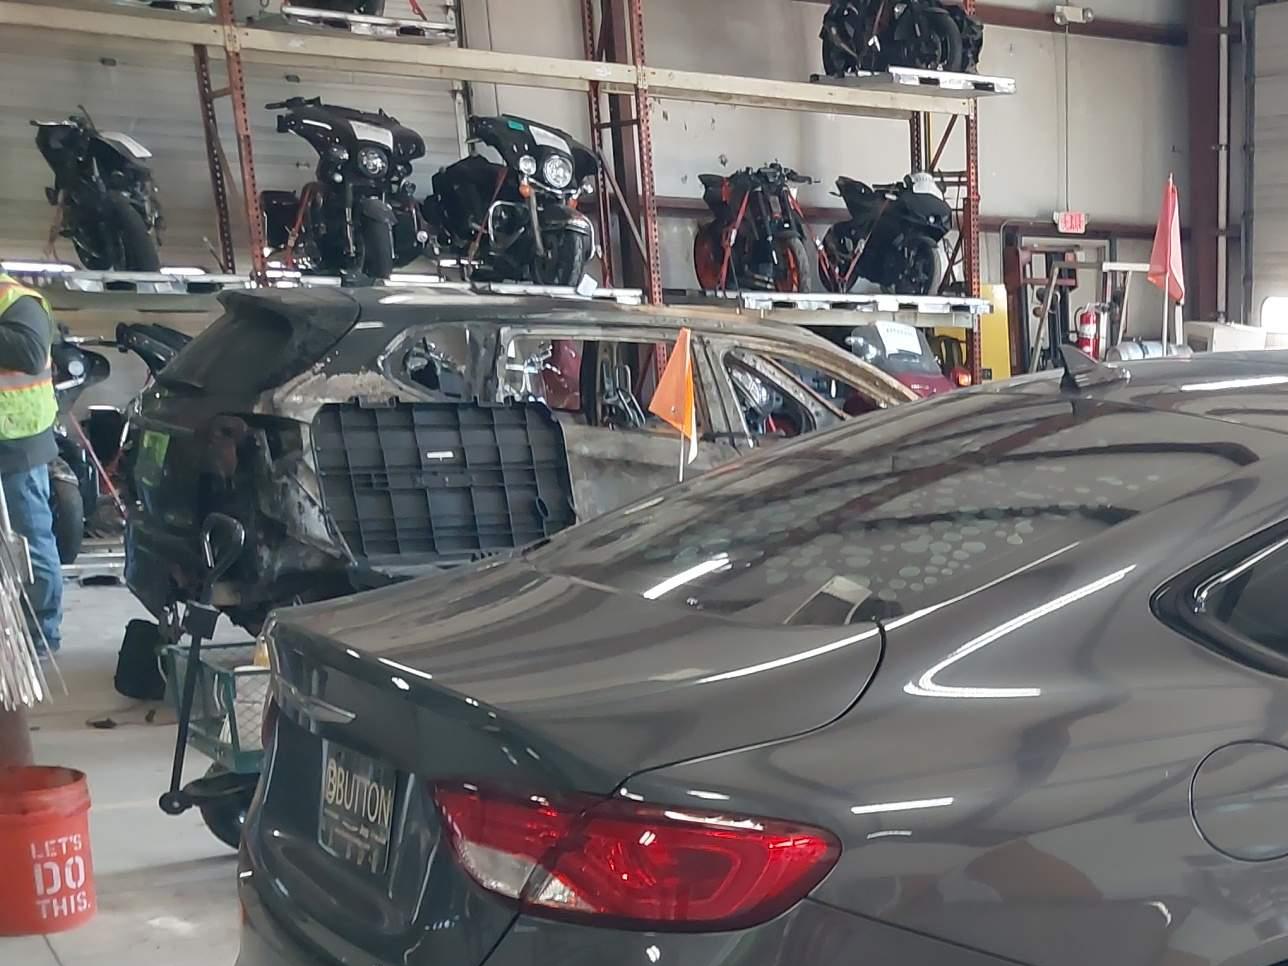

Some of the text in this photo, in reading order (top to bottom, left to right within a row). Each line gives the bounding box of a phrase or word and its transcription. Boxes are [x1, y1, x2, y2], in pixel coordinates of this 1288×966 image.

[31, 833, 82, 859] LET'S
[33, 855, 85, 896] DO
[36, 891, 91, 918] THIS.
